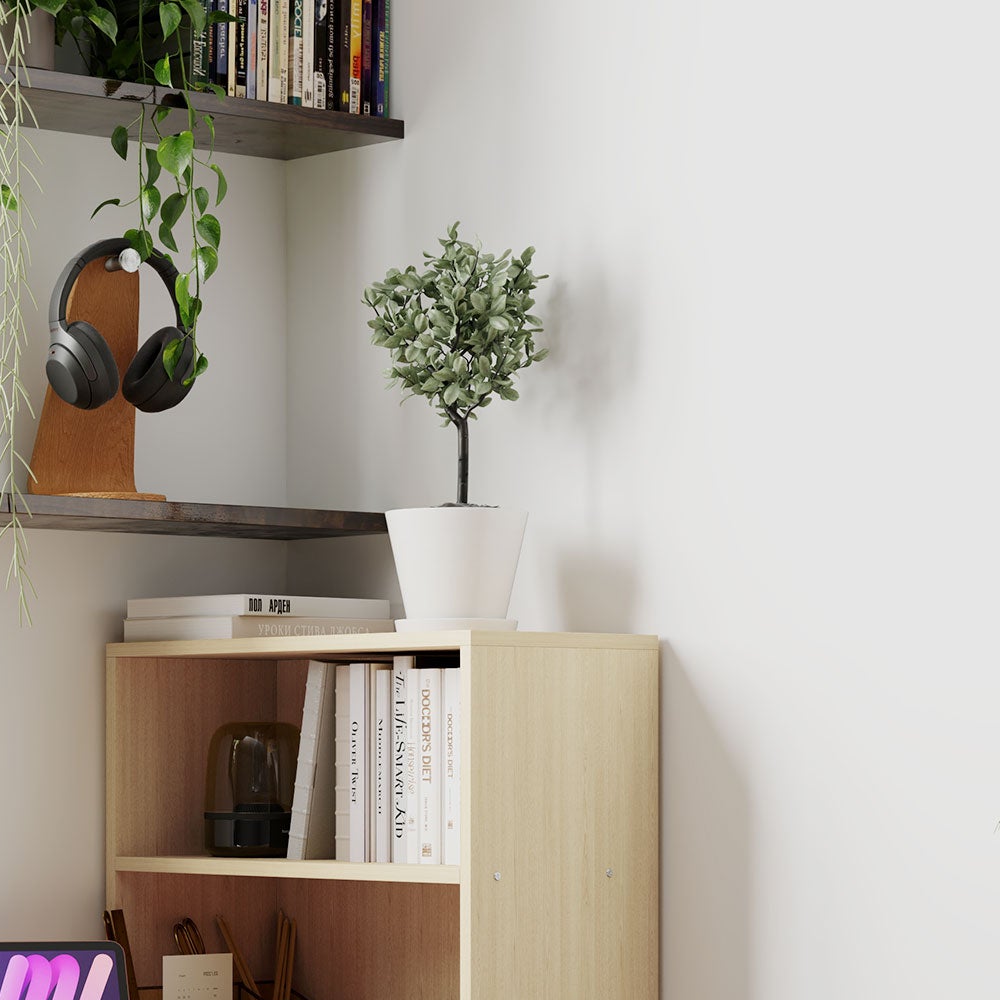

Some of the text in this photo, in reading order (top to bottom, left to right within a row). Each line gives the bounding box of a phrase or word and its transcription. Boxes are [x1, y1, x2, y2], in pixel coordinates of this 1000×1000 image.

[248, 598, 291, 614] ПОЛ АРДЕН
[258, 623, 292, 636] УРОКИ
[294, 624, 326, 636] СТИВА
[351, 721, 359, 804] OLIVER TWIST
[421, 755, 433, 784] DIET
